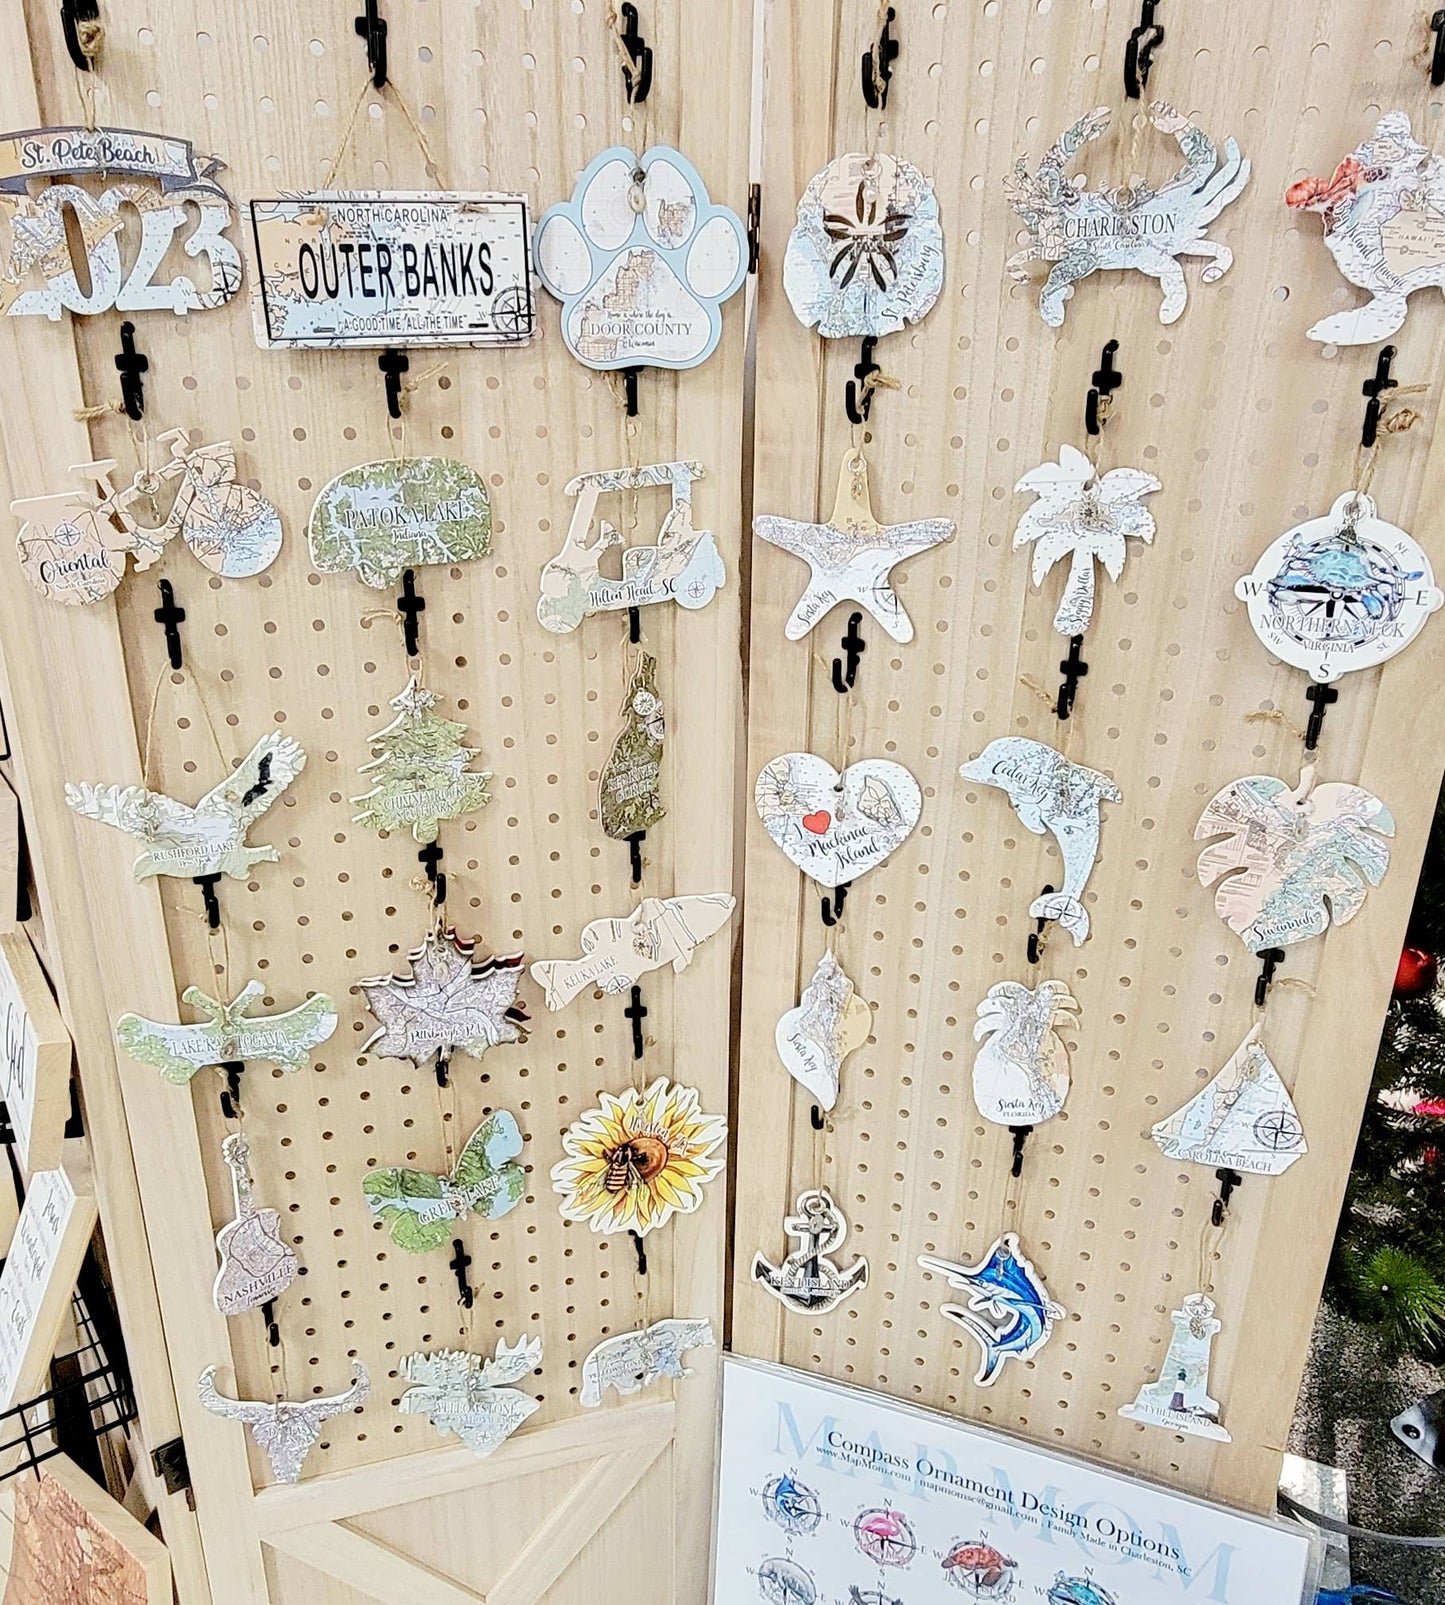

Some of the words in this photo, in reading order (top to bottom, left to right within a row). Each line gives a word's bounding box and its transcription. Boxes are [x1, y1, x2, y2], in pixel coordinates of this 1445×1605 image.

[21, 143, 50, 168] St.
[51, 142, 97, 163] Pete
[102, 141, 156, 164] Beach
[337, 208, 381, 222] NORTH
[384, 208, 449, 222] CAROLINA
[1334, 196, 1351, 230] Big
[299, 243, 396, 299] OUTER
[402, 243, 493, 297] BANKS
[895, 243, 940, 307] Petersburg
[352, 318, 379, 331] GOOD
[407, 316, 422, 330] ALL
[424, 316, 440, 330] THE
[591, 323, 632, 336] DOOR
[634, 323, 692, 336] COUNTY
[344, 503, 420, 530] PATOKA
[422, 500, 470, 522] LAKE
[392, 530, 428, 544] Indiana
[39, 548, 112, 584] Oriental
[56, 582, 76, 592] North
[76, 577, 107, 590] Carolina
[1076, 567, 1091, 596] Dollar
[1243, 581, 1263, 597] W
[589, 587, 623, 607] Hilton
[662, 576, 679, 595] SC
[1416, 590, 1430, 607] E
[797, 594, 821, 627] Siesta
[815, 588, 838, 608] Key
[1069, 598, 1091, 624] Soggy
[1260, 614, 1354, 634] NORTHERN
[1358, 618, 1407, 638] NECK
[1302, 639, 1355, 653] VIRGINIA
[1317, 663, 1330, 678] S
[991, 760, 1029, 785] Cedar
[1025, 776, 1049, 805] Key
[793, 822, 804, 841] I
[153, 844, 208, 861] RUSHFORD
[210, 840, 237, 852] LAKE
[808, 826, 870, 858] Mackinac
[836, 836, 880, 870] Island
[1253, 910, 1315, 943] Savannah
[563, 963, 596, 990] KEUKA
[595, 955, 618, 979] LAKE
[172, 1041, 206, 1055] LAKE
[786, 1032, 808, 1059] Siesta
[803, 1054, 819, 1074] Key
[996, 1098, 1026, 1112] Siesta
[1027, 1098, 1046, 1115] Key
[1177, 1148, 1234, 1167] CAROLINA
[1234, 1156, 1273, 1172] BEACH
[466, 1176, 501, 1201] LAKE
[224, 1265, 295, 1305] NASHVILLE
[771, 1276, 805, 1287] KENT
[805, 1277, 851, 1290] ISLAND
[1144, 1405, 1175, 1419] TYBEE
[1174, 1411, 1211, 1428] ISLAND
[1161, 1417, 1189, 1430] Georgia
[789, 1467, 798, 1476] N
[749, 1487, 759, 1496] W
[828, 1431, 909, 1470] Compass
[915, 1457, 1015, 1504] Ornament
[1021, 1491, 1088, 1529] Design
[1096, 1517, 1180, 1560] Options
[884, 1498, 893, 1507] N
[816, 1446, 911, 1483] www.MapMom.com
[919, 1479, 1038, 1524] mapmomsc@gmail.com
[1047, 1519, 1078, 1540] Family
[1080, 1531, 1106, 1547] Made
[1108, 1543, 1118, 1552] in
[1120, 1545, 1174, 1572] Charleston,
[1176, 1564, 1193, 1577] SC
[839, 1518, 850, 1528] W
[786, 1535, 793, 1544] S
[980, 1529, 989, 1539] N
[785, 1547, 794, 1557] N
[920, 1545, 927, 1554] E
[932, 1549, 944, 1560] W
[745, 1566, 756, 1575] W
[879, 1568, 886, 1577] S
[1084, 1566, 1094, 1576] N
[877, 1580, 886, 1590] N
[1034, 1585, 1045, 1596] W
